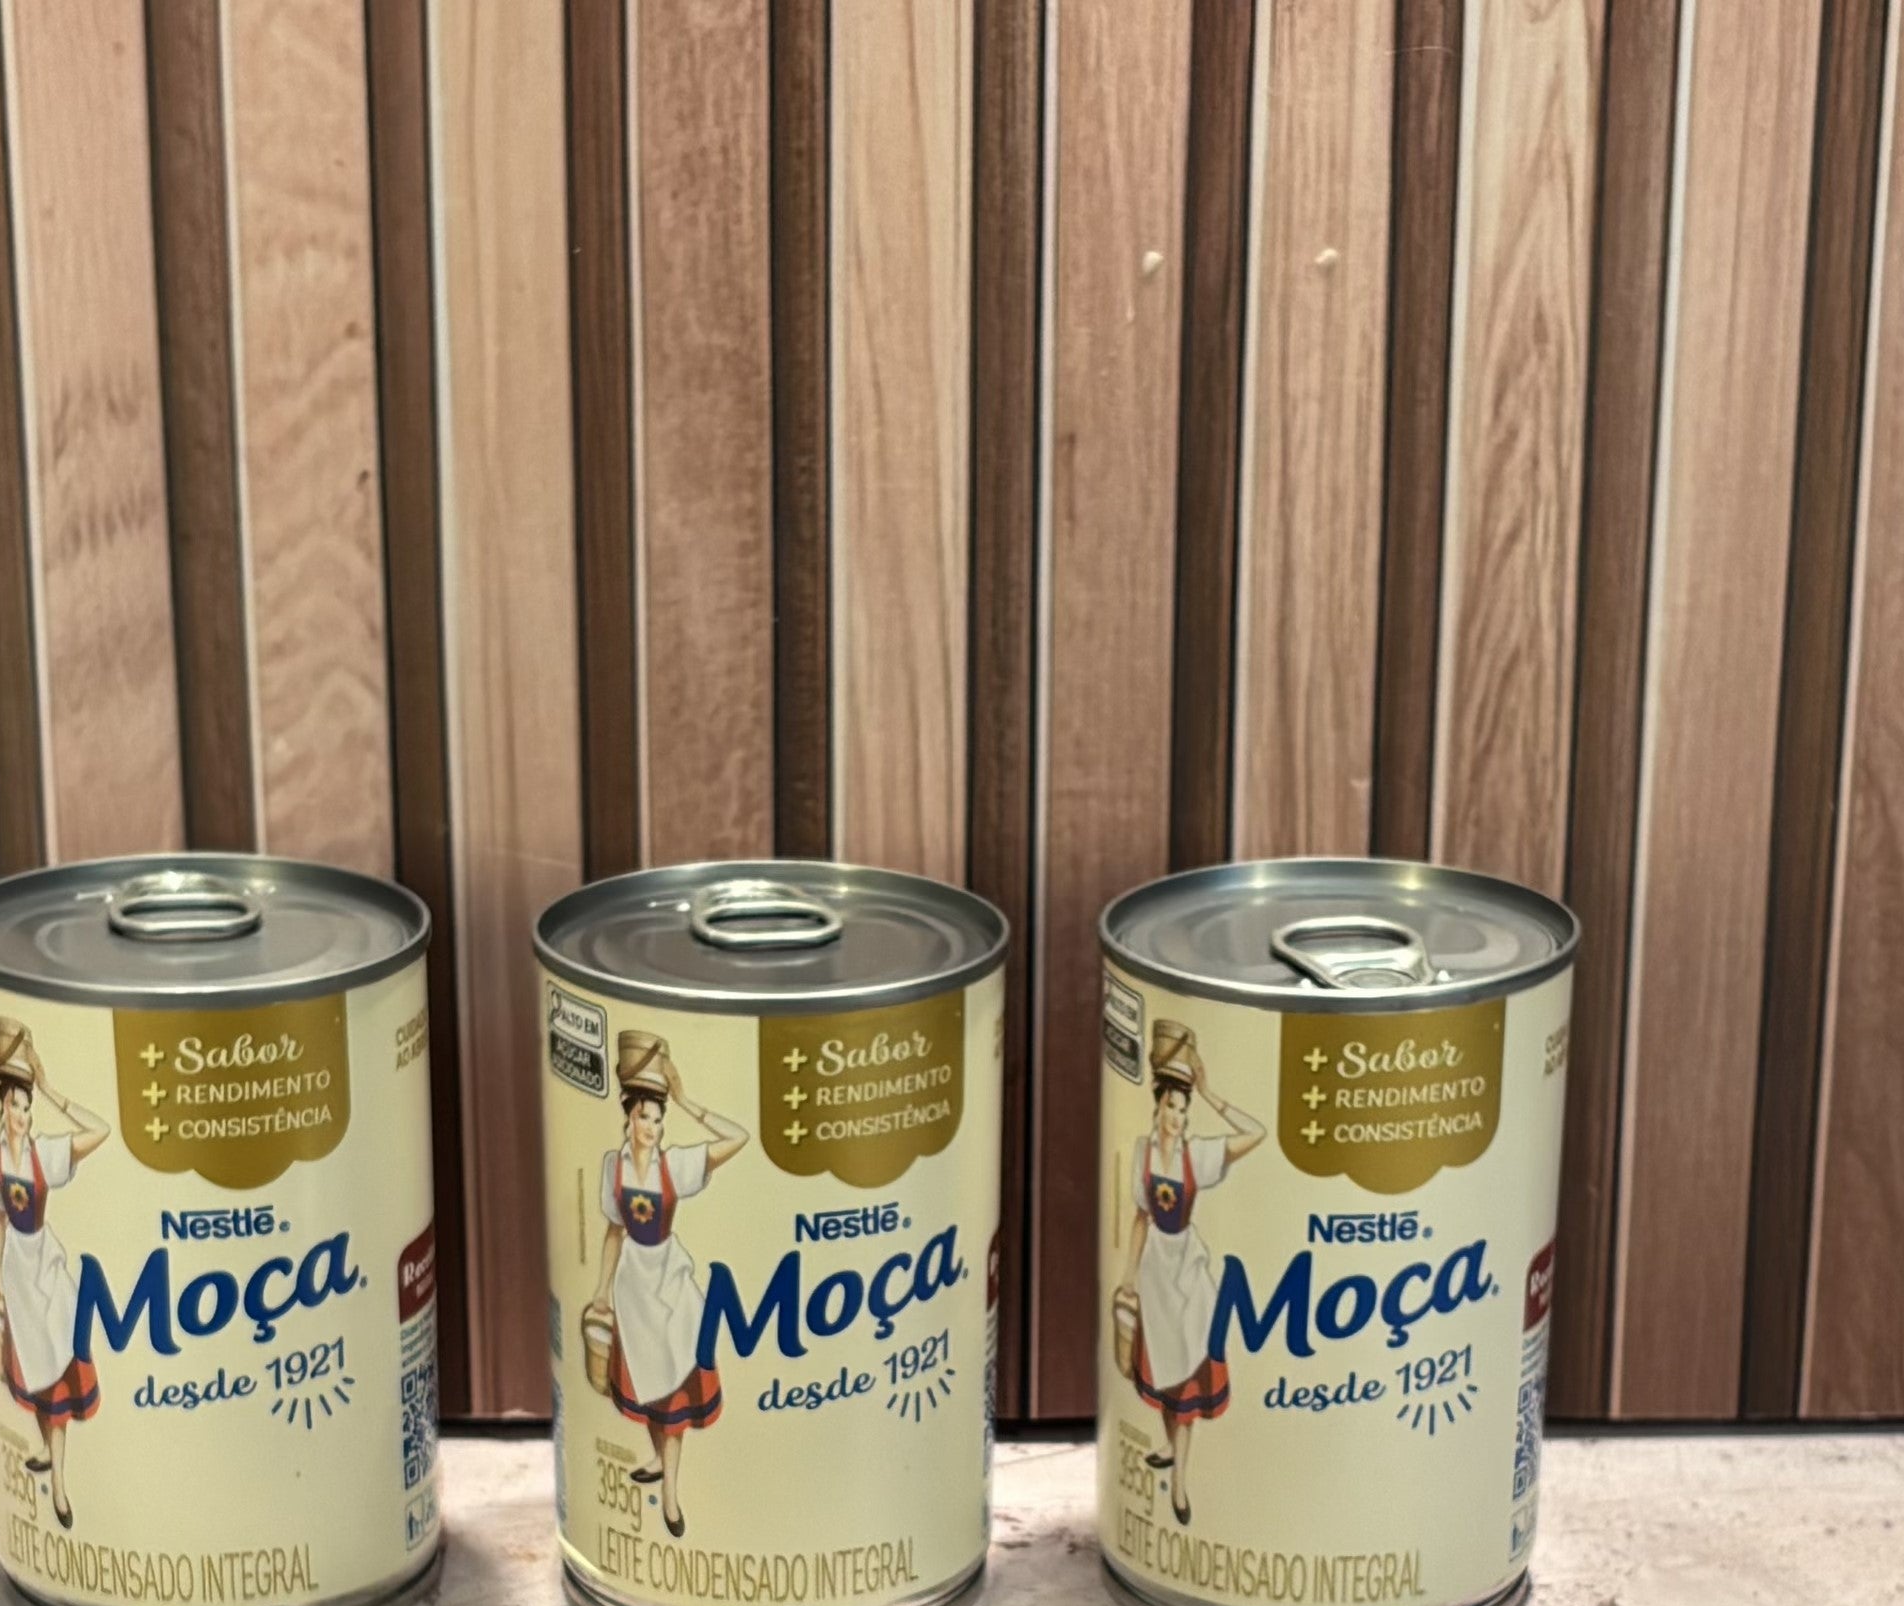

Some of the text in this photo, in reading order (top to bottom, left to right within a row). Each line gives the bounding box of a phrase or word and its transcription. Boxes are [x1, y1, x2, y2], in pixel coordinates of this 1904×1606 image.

[584, 1017, 600, 1035] EM
[174, 1033, 304, 1074] Sabor
[816, 1030, 933, 1076] Sabor
[1336, 1039, 1463, 1079] Sabor
[176, 1069, 331, 1104] RENDIMENTO
[816, 1064, 952, 1107] RENDIMENTO
[1335, 1076, 1486, 1108] RENDIMENTO
[178, 1104, 333, 1139] CONSISTÊNCIA
[815, 1100, 951, 1141] CONSISTÊNCIA
[1333, 1111, 1484, 1142] CONSISTÊNCIA
[161, 1205, 274, 1239] Nestlé
[795, 1201, 899, 1242] Nestlé
[1308, 1211, 1418, 1242] Nestlé
[73, 1231, 359, 1363] Moça
[696, 1224, 963, 1370] Moça
[1207, 1239, 1492, 1363] Moça
[134, 1336, 344, 1408] desde 1921
[757, 1367, 876, 1411] desde
[883, 1328, 949, 1384] 1921
[1264, 1372, 1386, 1412] desde
[1395, 1344, 1471, 1395] 1921
[597, 1457, 642, 1532] 395g
[7, 1508, 319, 1603] LEITE CONDENSADO INTEGRAL
[598, 1523, 919, 1603] LEITE CONDENSADO INTEGRAL
[1117, 1500, 1426, 1603] LEITE CONDENSADO INTEGRAL
